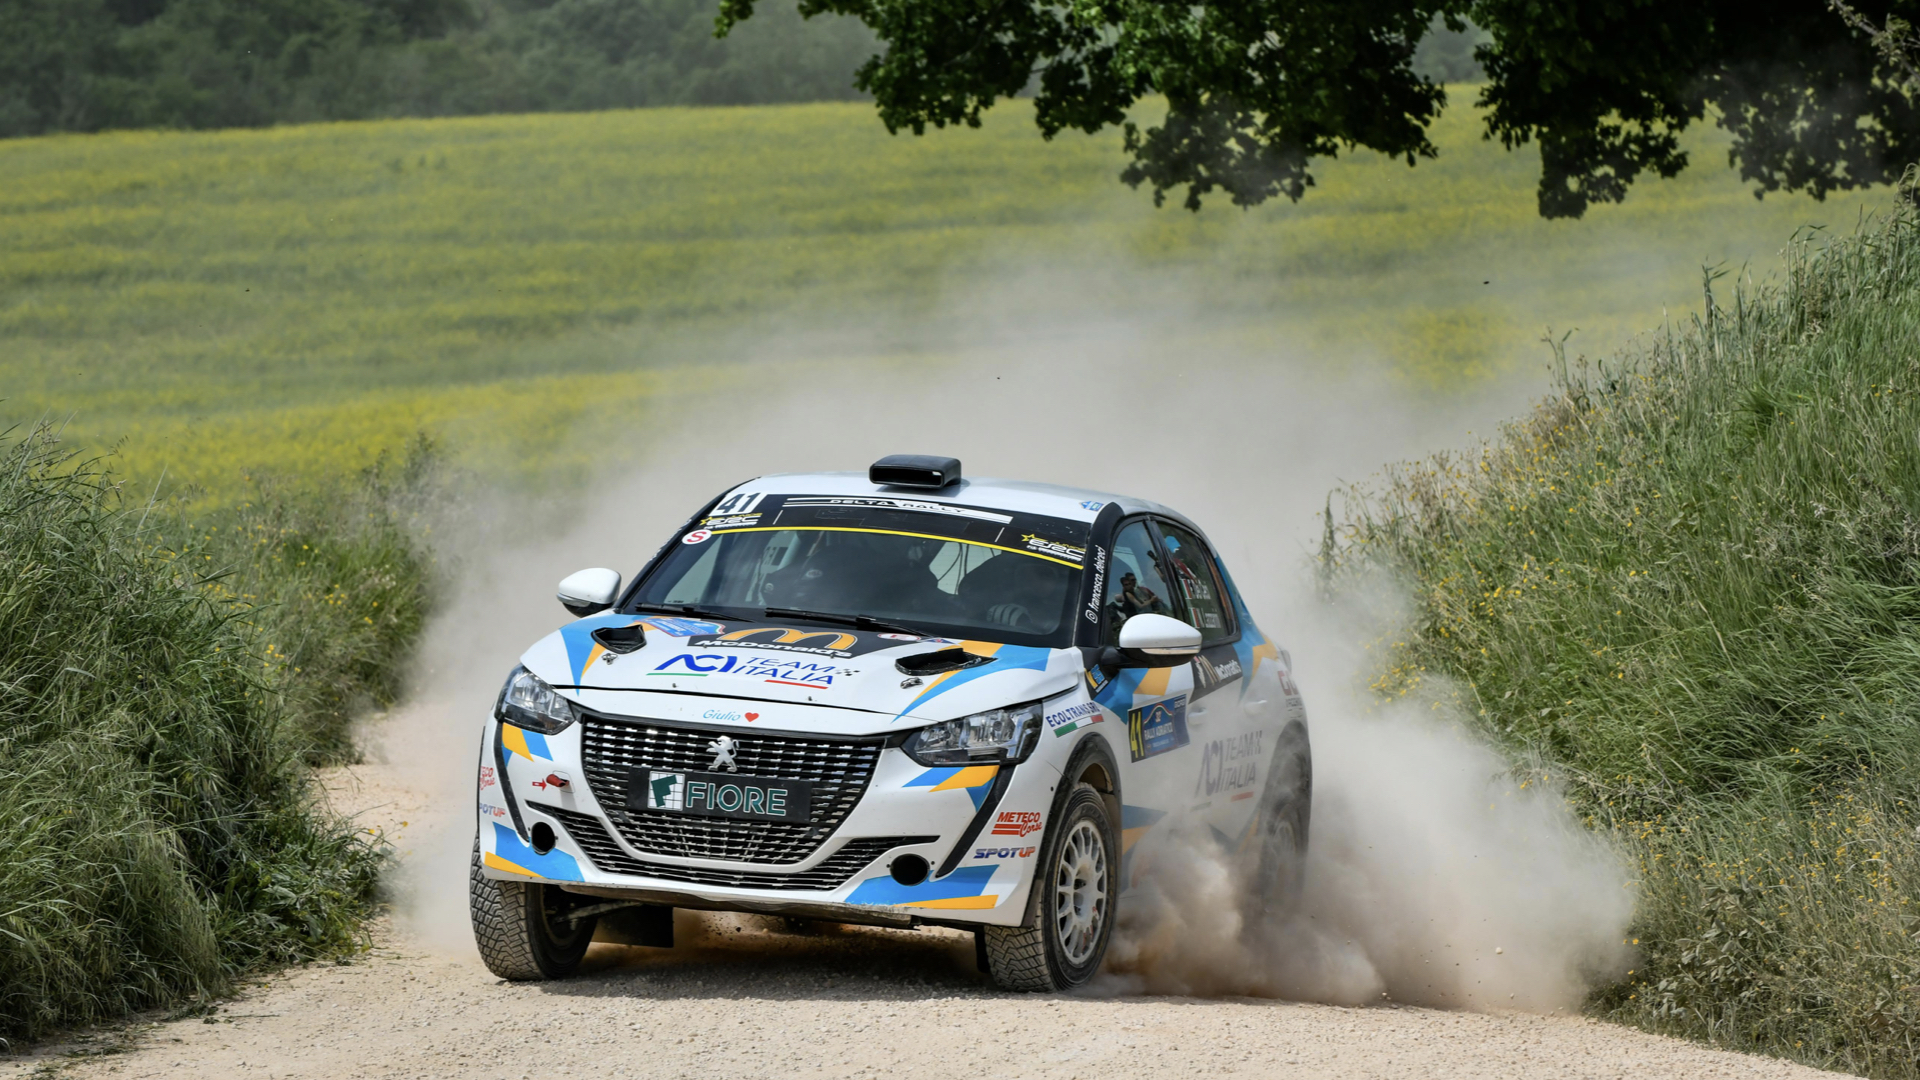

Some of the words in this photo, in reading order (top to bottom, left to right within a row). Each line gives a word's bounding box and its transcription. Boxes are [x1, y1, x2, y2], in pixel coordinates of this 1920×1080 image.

[716, 492, 761, 513] 41
[902, 503, 966, 513] RALLY
[687, 531, 707, 543] S
[1028, 538, 1086, 558] ERC
[695, 640, 853, 657] McDonald's
[654, 654, 738, 673] ACI
[747, 656, 836, 673] TEAM
[732, 665, 834, 685] ITALIA
[703, 709, 741, 721] Giulio
[1130, 711, 1144, 759] 41
[686, 780, 788, 816] FIORE
[479, 803, 506, 818] POTUP
[996, 811, 1041, 823] METECO
[1019, 821, 1043, 838] Corse
[973, 846, 1036, 859] SPOTUP
